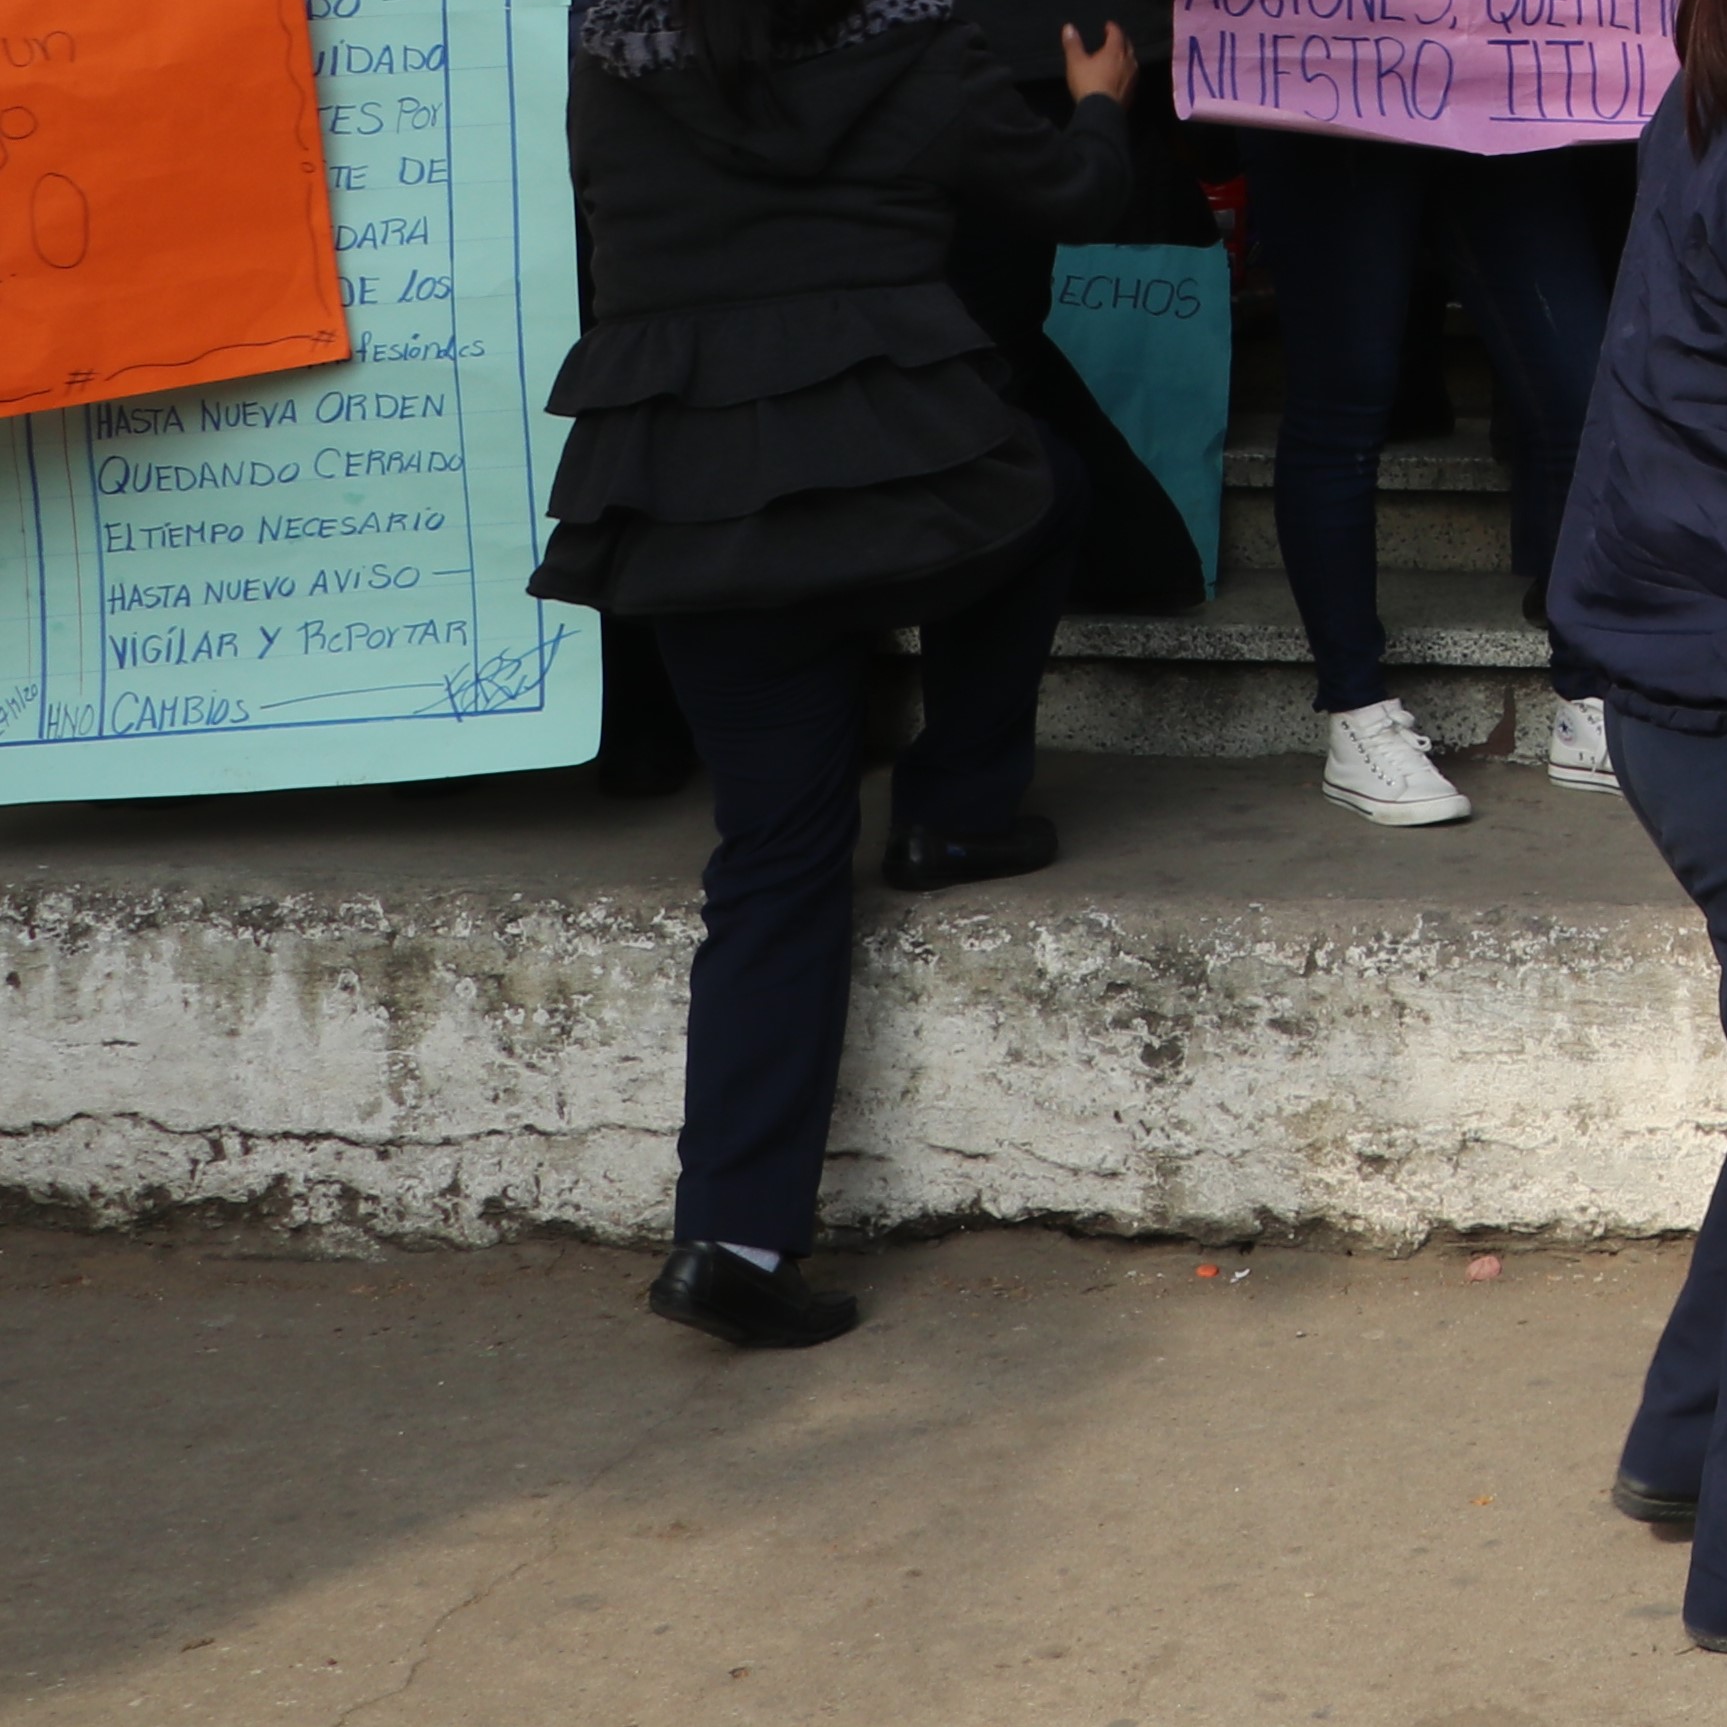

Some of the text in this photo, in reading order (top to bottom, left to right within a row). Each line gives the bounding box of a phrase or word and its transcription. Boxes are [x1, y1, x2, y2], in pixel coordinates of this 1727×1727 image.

[1487, 40, 1656, 121] TITUL
[97, 391, 445, 440] HASTA NUEVA ORDEN
[99, 447, 466, 495] QUEDANDO CERRADO
[109, 576, 295, 616] HASTA NUEVO
